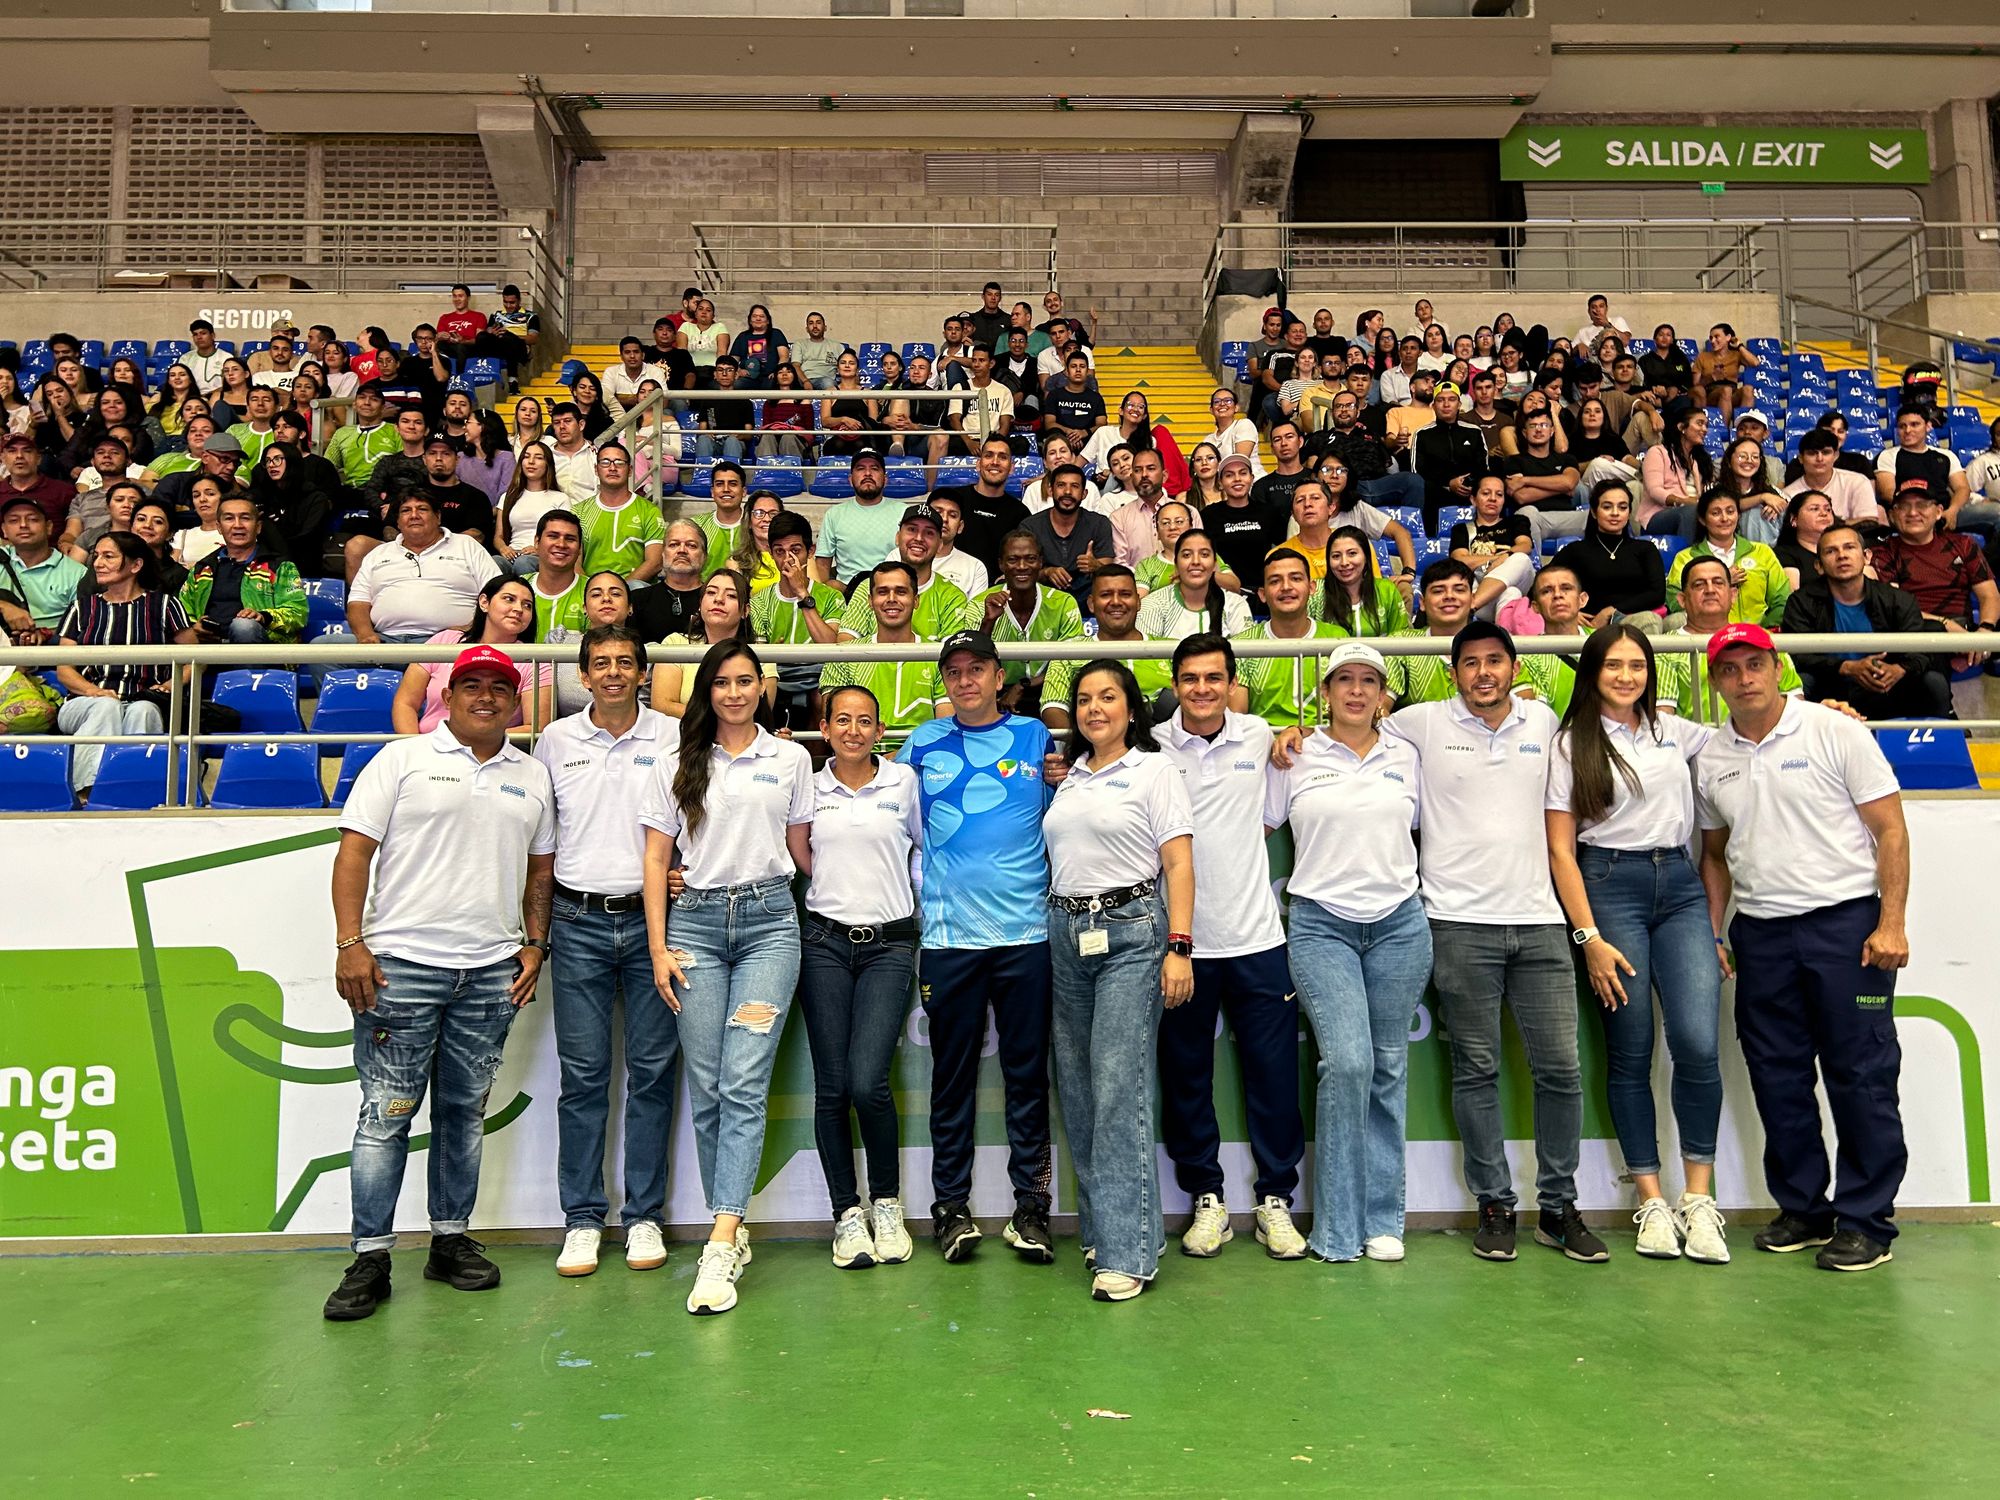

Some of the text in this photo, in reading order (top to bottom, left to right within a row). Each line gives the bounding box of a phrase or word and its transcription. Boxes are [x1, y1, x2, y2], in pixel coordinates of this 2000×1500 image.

[1605, 140, 1825, 167] SALIDA / EXIT
[256, 342, 262, 350] 8
[476, 358, 488, 366] 14
[1800, 354, 1810, 362] 44
[1848, 370, 1860, 379] 44
[450, 376, 461, 384] 14
[860, 376, 871, 384] 22
[1850, 388, 1862, 396] 43
[1058, 401, 1092, 409] NAUTICA
[1798, 408, 1810, 418] 41
[1850, 408, 1862, 418] 42
[1952, 408, 1966, 417] 44
[1014, 458, 1028, 468] 25
[1456, 508, 1472, 520] 32
[1224, 524, 1262, 534] RUNNING
[1426, 540, 1440, 553] 31
[302, 582, 322, 596] 17
[322, 624, 344, 635] 18
[252, 674, 263, 691] 7
[355, 674, 368, 691] 8
[1908, 728, 1935, 743] 22
[15, 744, 28, 760] 6
[563, 759, 590, 769] INDERBU
[926, 772, 954, 781] Deporte
[1312, 772, 1340, 782] INDERBU
[0, 1119, 116, 1172] eta
